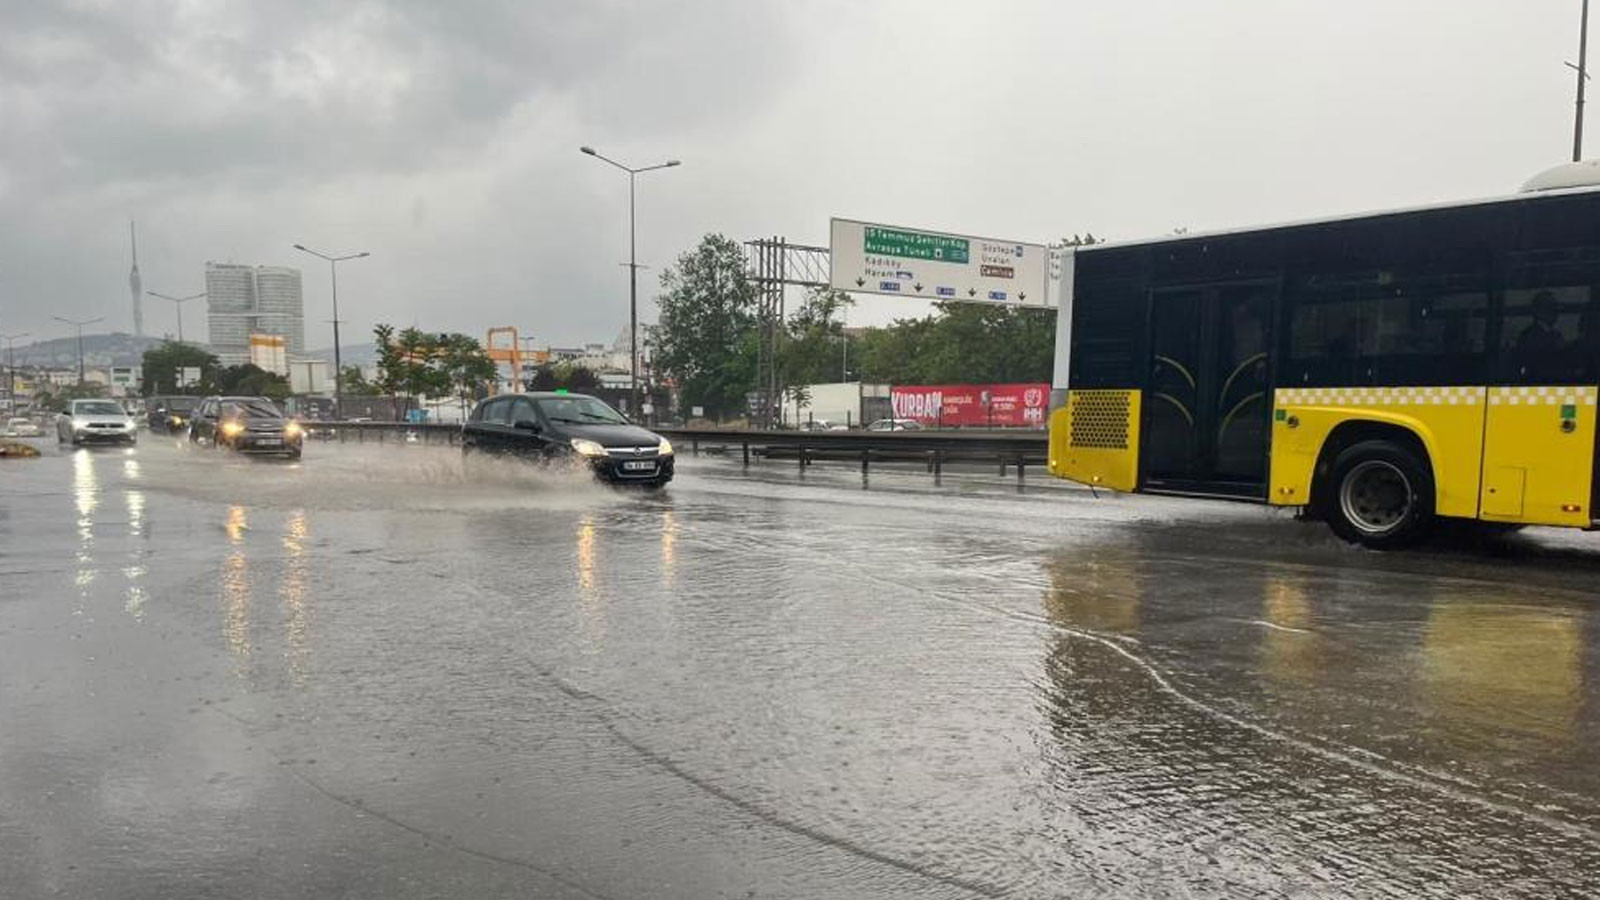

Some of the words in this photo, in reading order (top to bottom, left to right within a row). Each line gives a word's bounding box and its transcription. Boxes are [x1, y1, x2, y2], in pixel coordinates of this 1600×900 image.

[877, 229, 914, 243] Temmuz
[866, 241, 901, 254] Avrasya
[865, 257, 901, 268] Kadıköy
[891, 391, 942, 418] KURBAN
